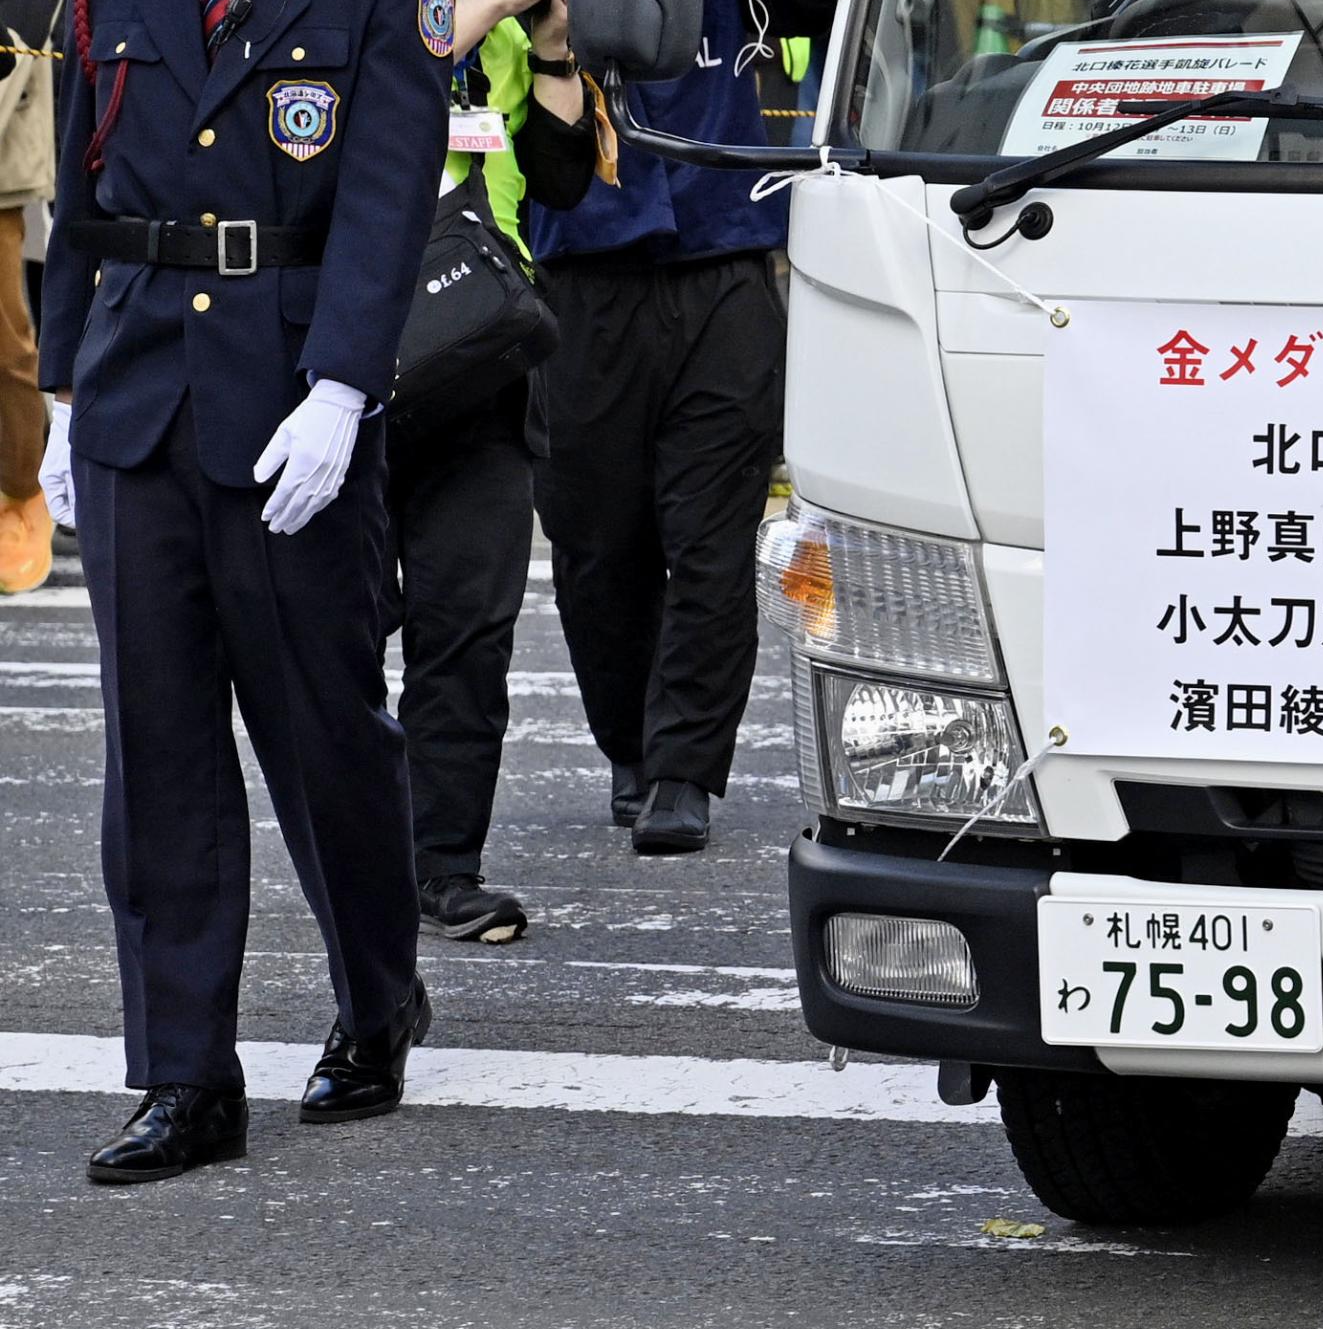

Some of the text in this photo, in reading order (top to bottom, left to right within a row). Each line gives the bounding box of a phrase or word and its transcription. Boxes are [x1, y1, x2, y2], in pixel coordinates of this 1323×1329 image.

[456, 136, 494, 149] STAFF
[1057, 960, 1306, 1039] わ 75-98
